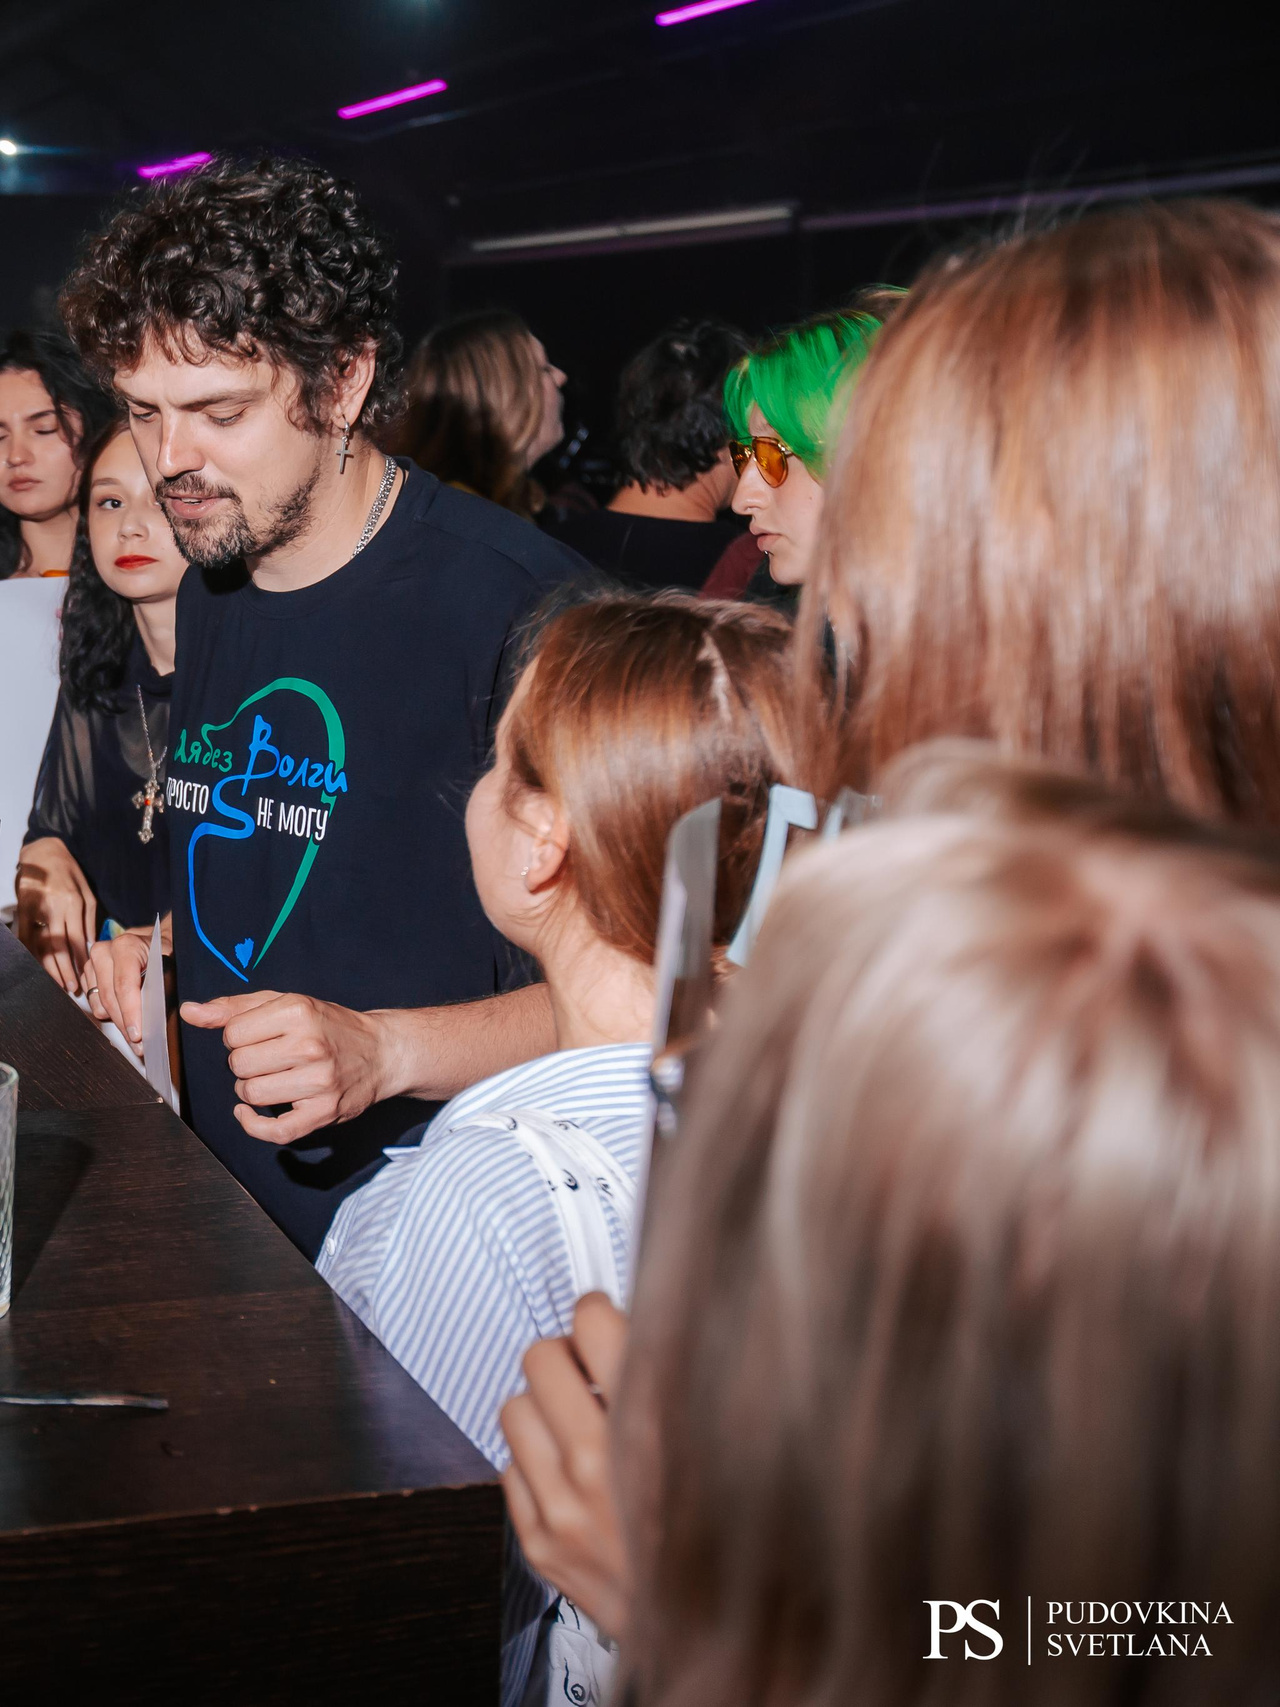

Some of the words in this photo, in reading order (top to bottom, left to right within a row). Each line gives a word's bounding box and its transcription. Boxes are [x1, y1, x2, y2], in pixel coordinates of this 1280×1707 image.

[241, 714, 348, 795] Волги
[256, 796, 273, 829] НЕ
[278, 802, 330, 841] МОГУ
